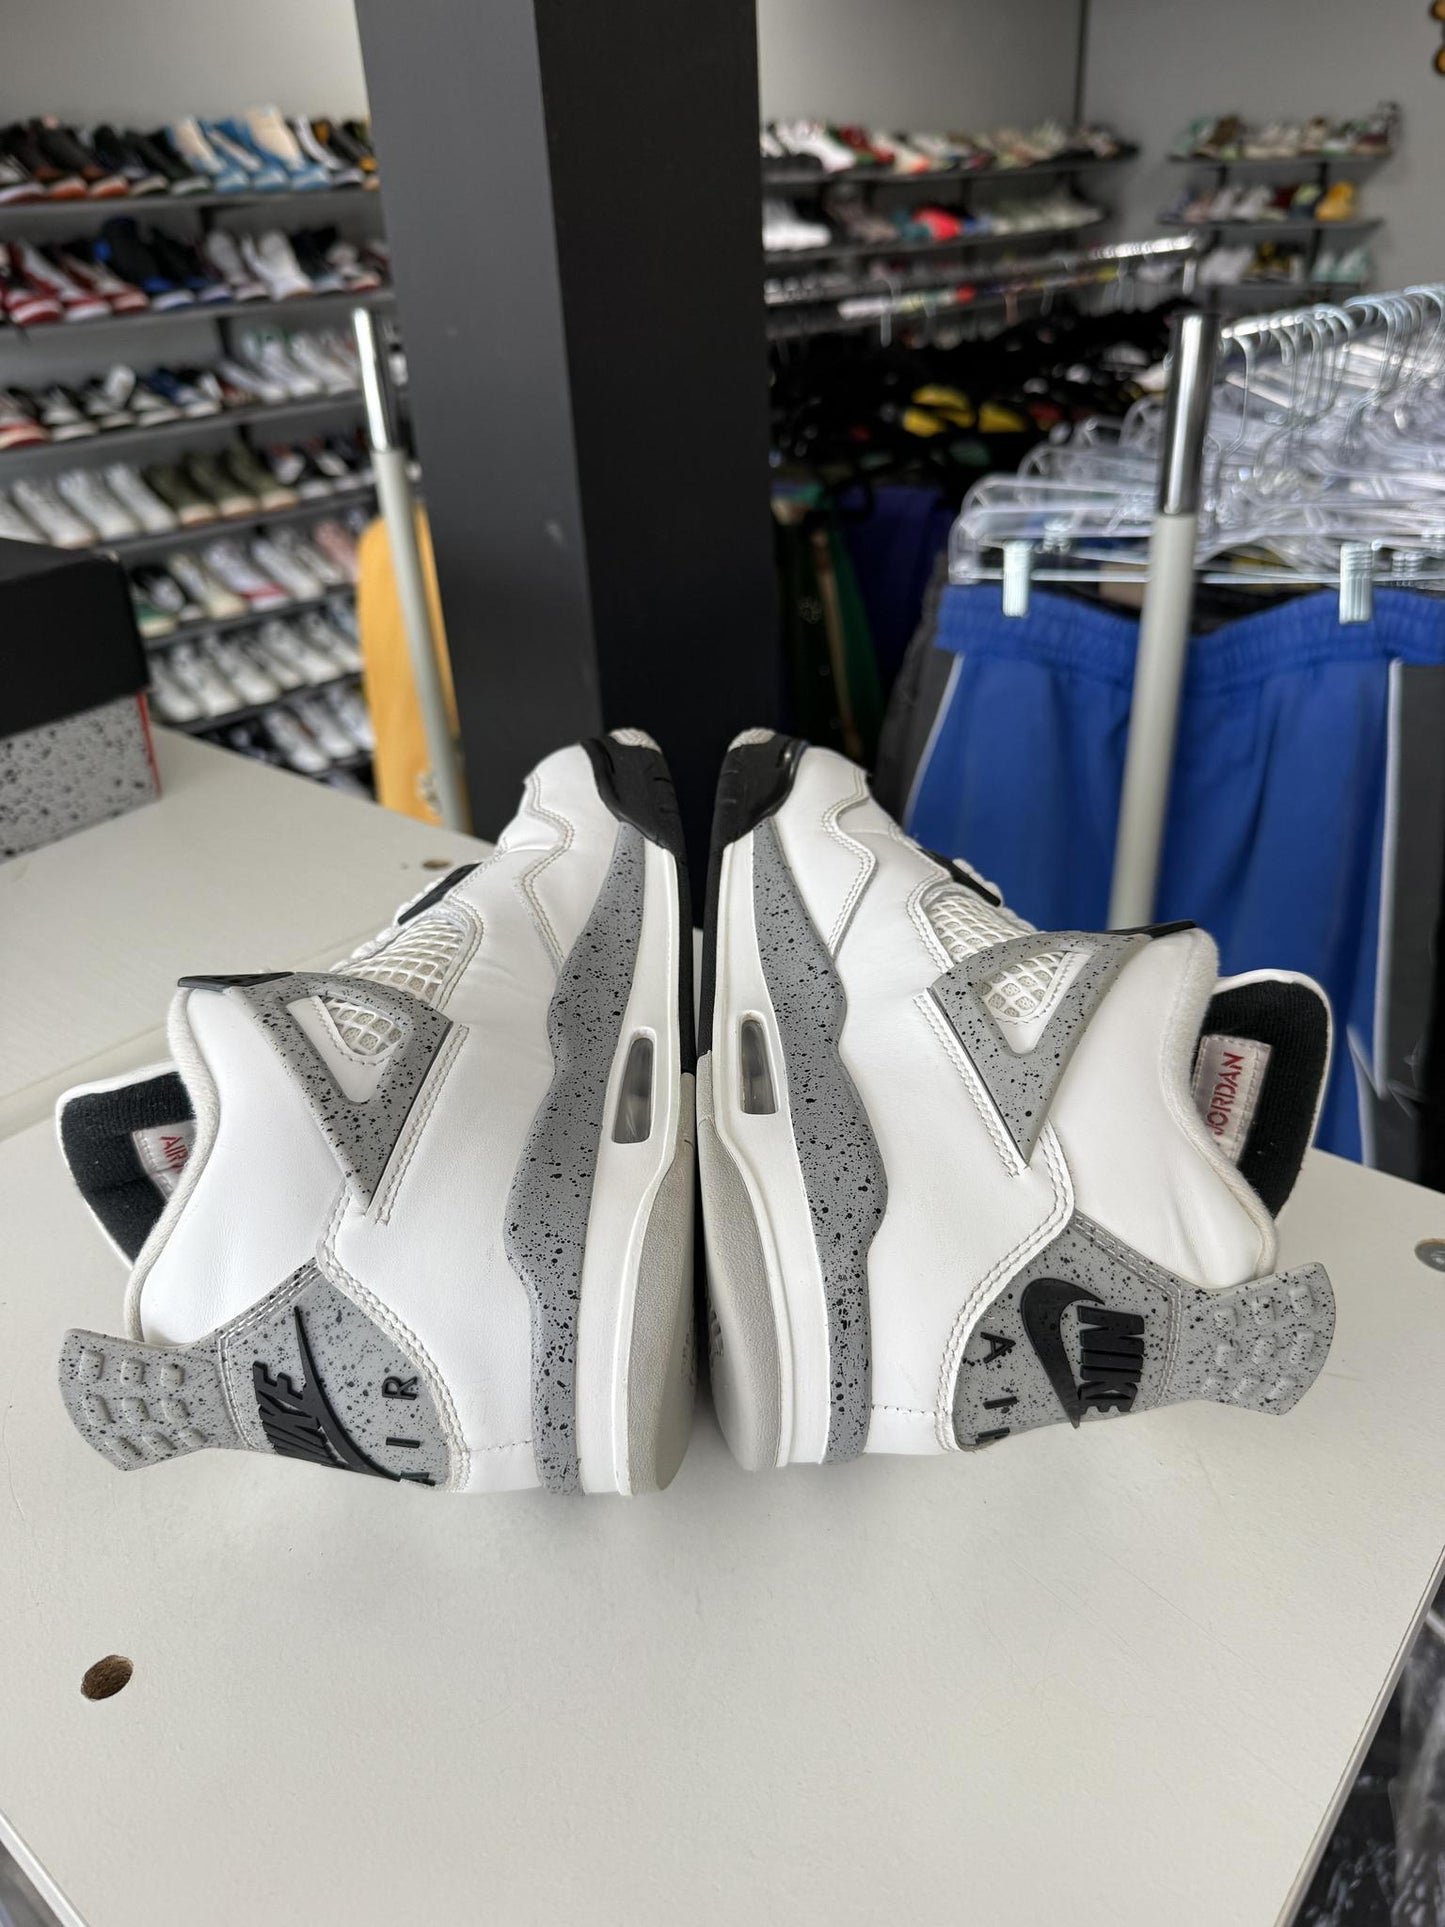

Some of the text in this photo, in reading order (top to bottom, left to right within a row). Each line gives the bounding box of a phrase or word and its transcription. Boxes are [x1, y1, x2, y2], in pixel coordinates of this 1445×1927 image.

[1204, 1051, 1245, 1136] JORDAN
[159, 1135, 189, 1162] AIR
[1075, 1304, 1145, 1414] NIKE
